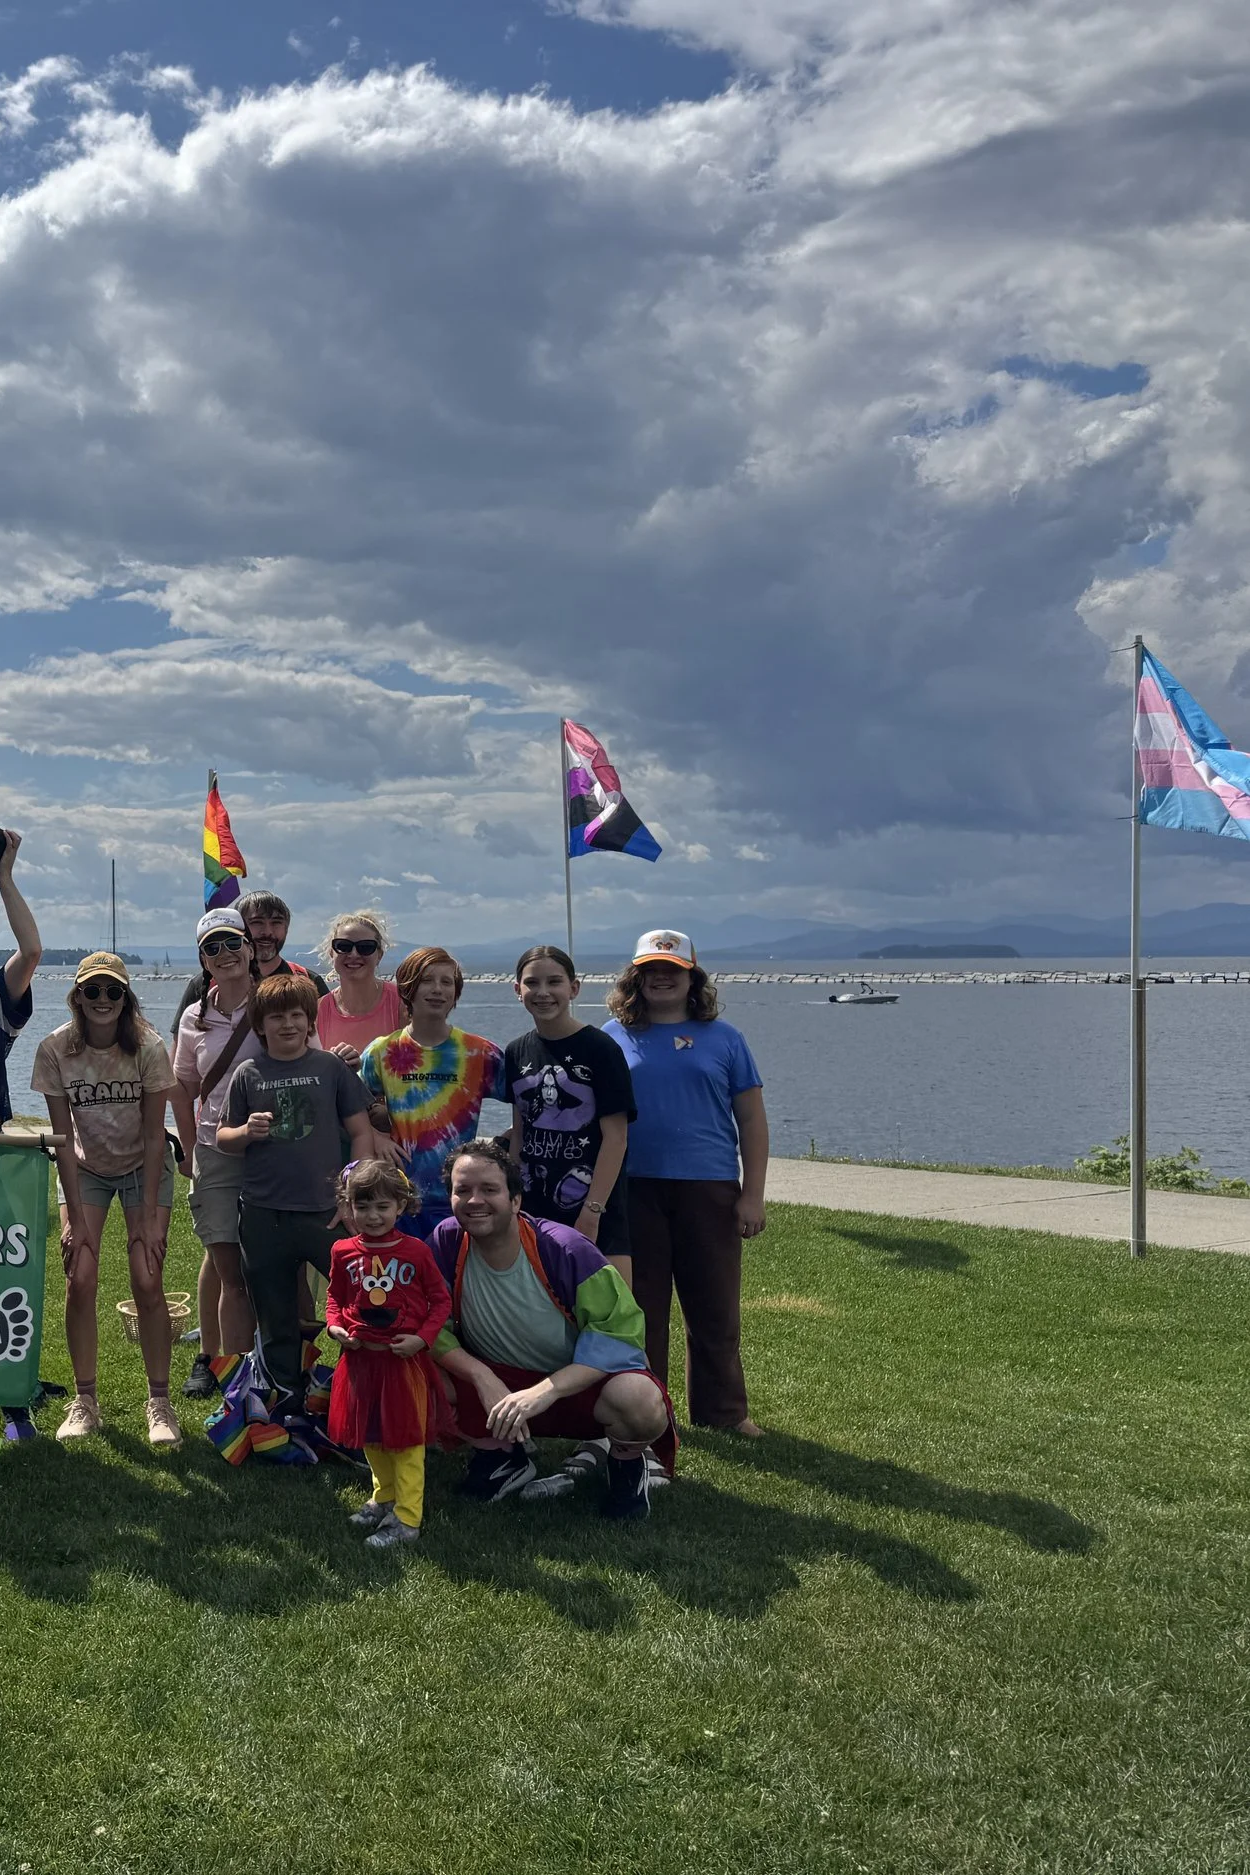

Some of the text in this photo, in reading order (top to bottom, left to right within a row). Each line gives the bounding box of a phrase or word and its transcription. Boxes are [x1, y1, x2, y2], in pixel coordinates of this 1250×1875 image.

[257, 1076, 320, 1090] MINECRAFT
[523, 1140, 583, 1159] ODRIGO
[346, 1254, 416, 1285] ELMO
